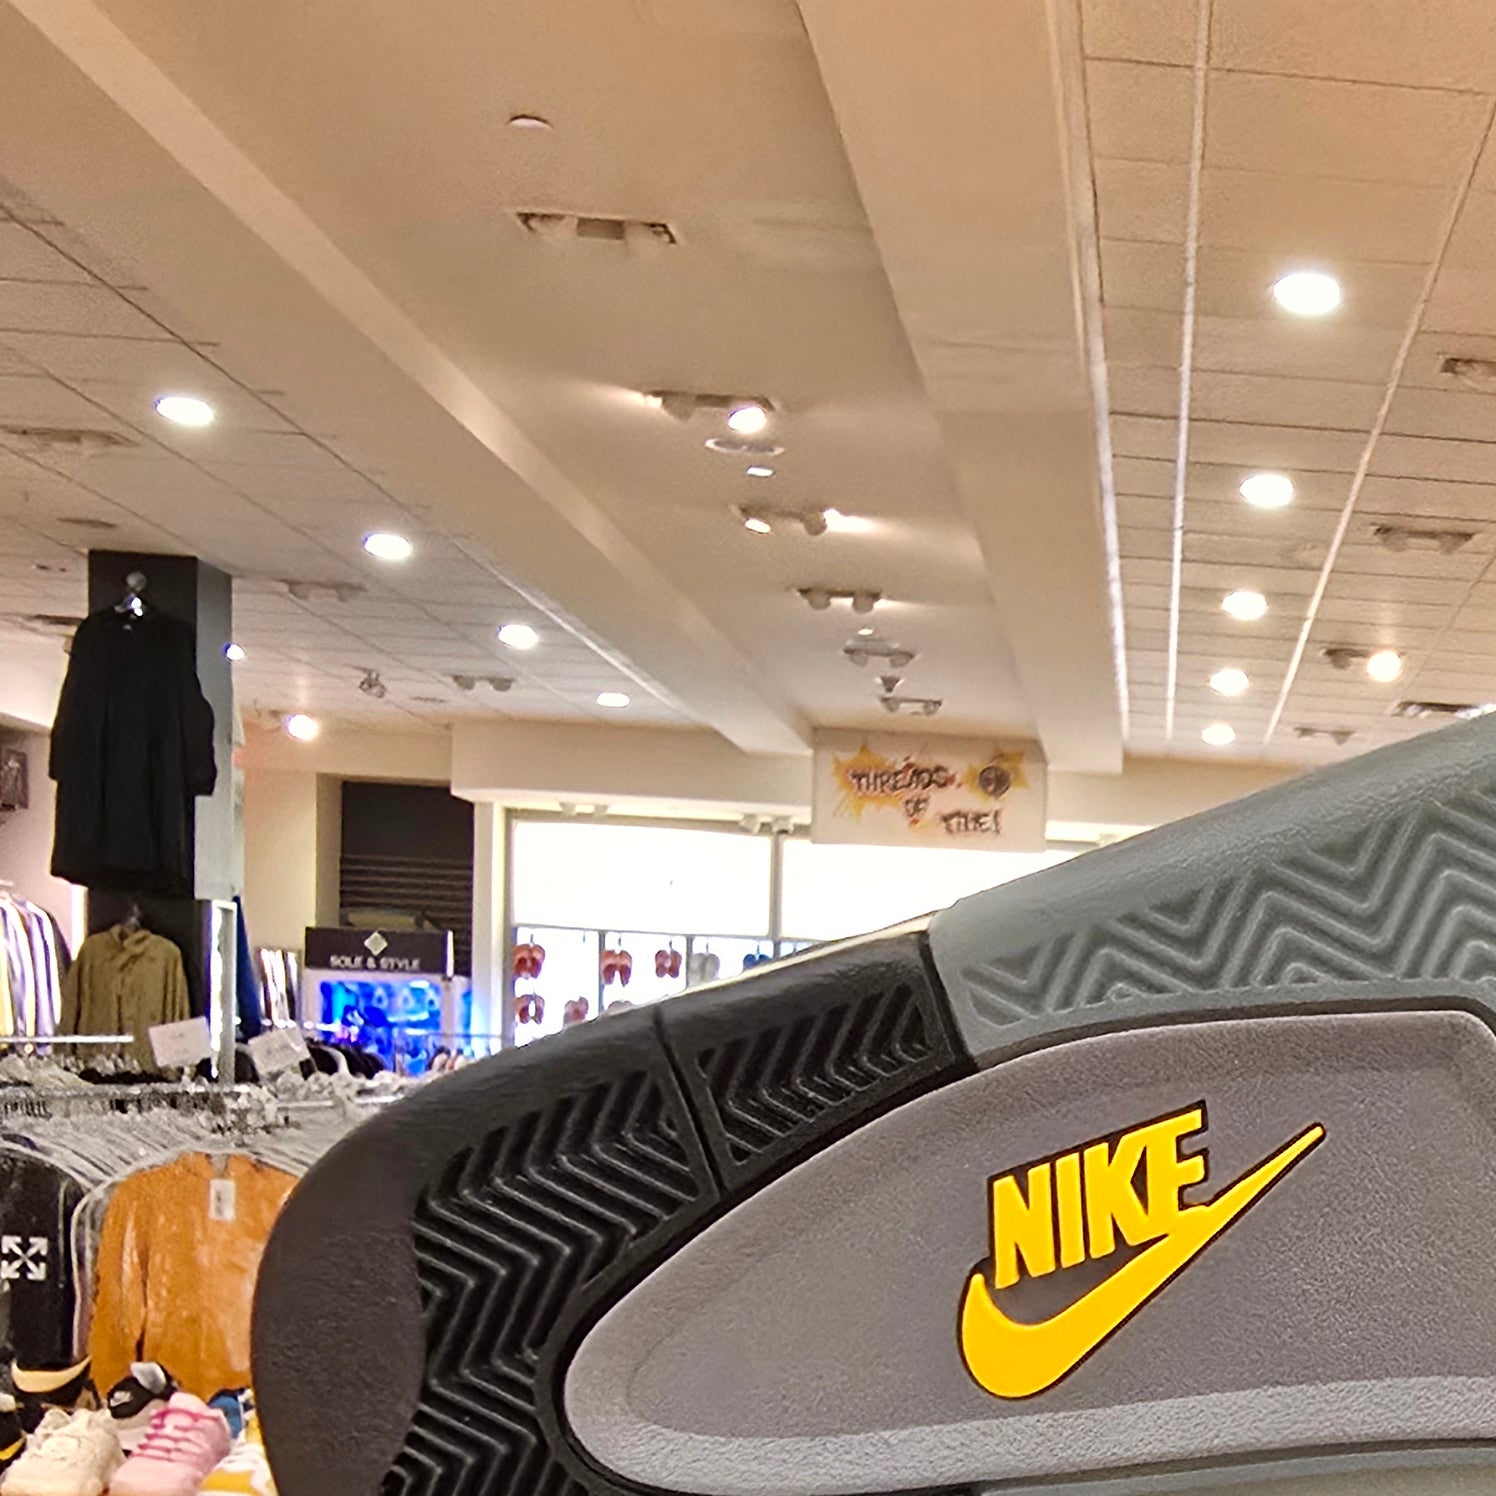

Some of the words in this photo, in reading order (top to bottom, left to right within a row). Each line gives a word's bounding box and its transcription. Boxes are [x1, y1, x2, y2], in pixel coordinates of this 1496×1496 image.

[850, 765, 948, 794] THREADS
[904, 798, 928, 817] OF
[330, 955, 363, 969] SOLE
[366, 957, 377, 970] &
[380, 957, 420, 970] STYLE
[990, 1102, 1206, 1289] NIKE
